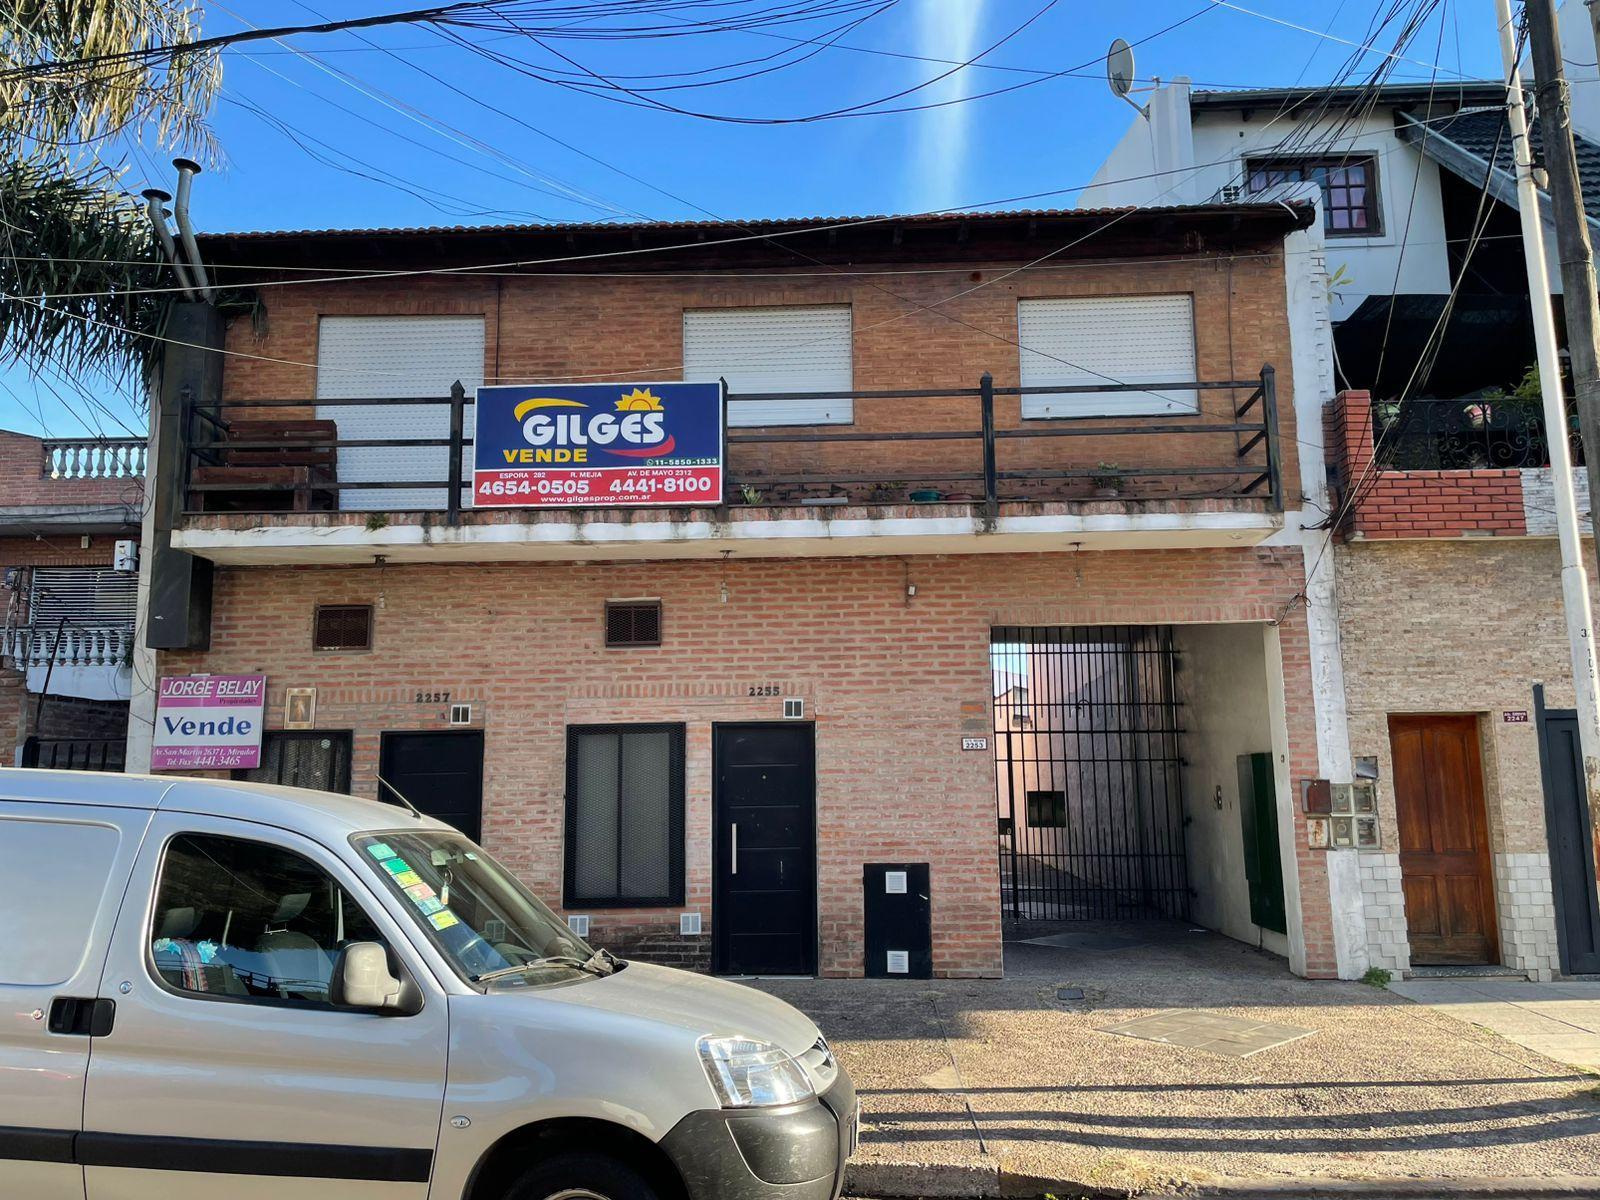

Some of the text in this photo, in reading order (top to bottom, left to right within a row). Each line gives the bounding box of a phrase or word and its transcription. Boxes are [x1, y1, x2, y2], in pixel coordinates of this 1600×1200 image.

[523, 412, 665, 446] GILGES
[503, 448, 588, 463] VENDE
[479, 480, 590, 495] 4654-0505
[609, 477, 711, 493] 4441-8100
[540, 494, 652, 503] www.gilgesprop.com.ar
[162, 680, 262, 695] JORGE BELAY
[749, 686, 780, 697] 2255
[416, 692, 450, 703] 2257
[163, 716, 252, 736] Vende
